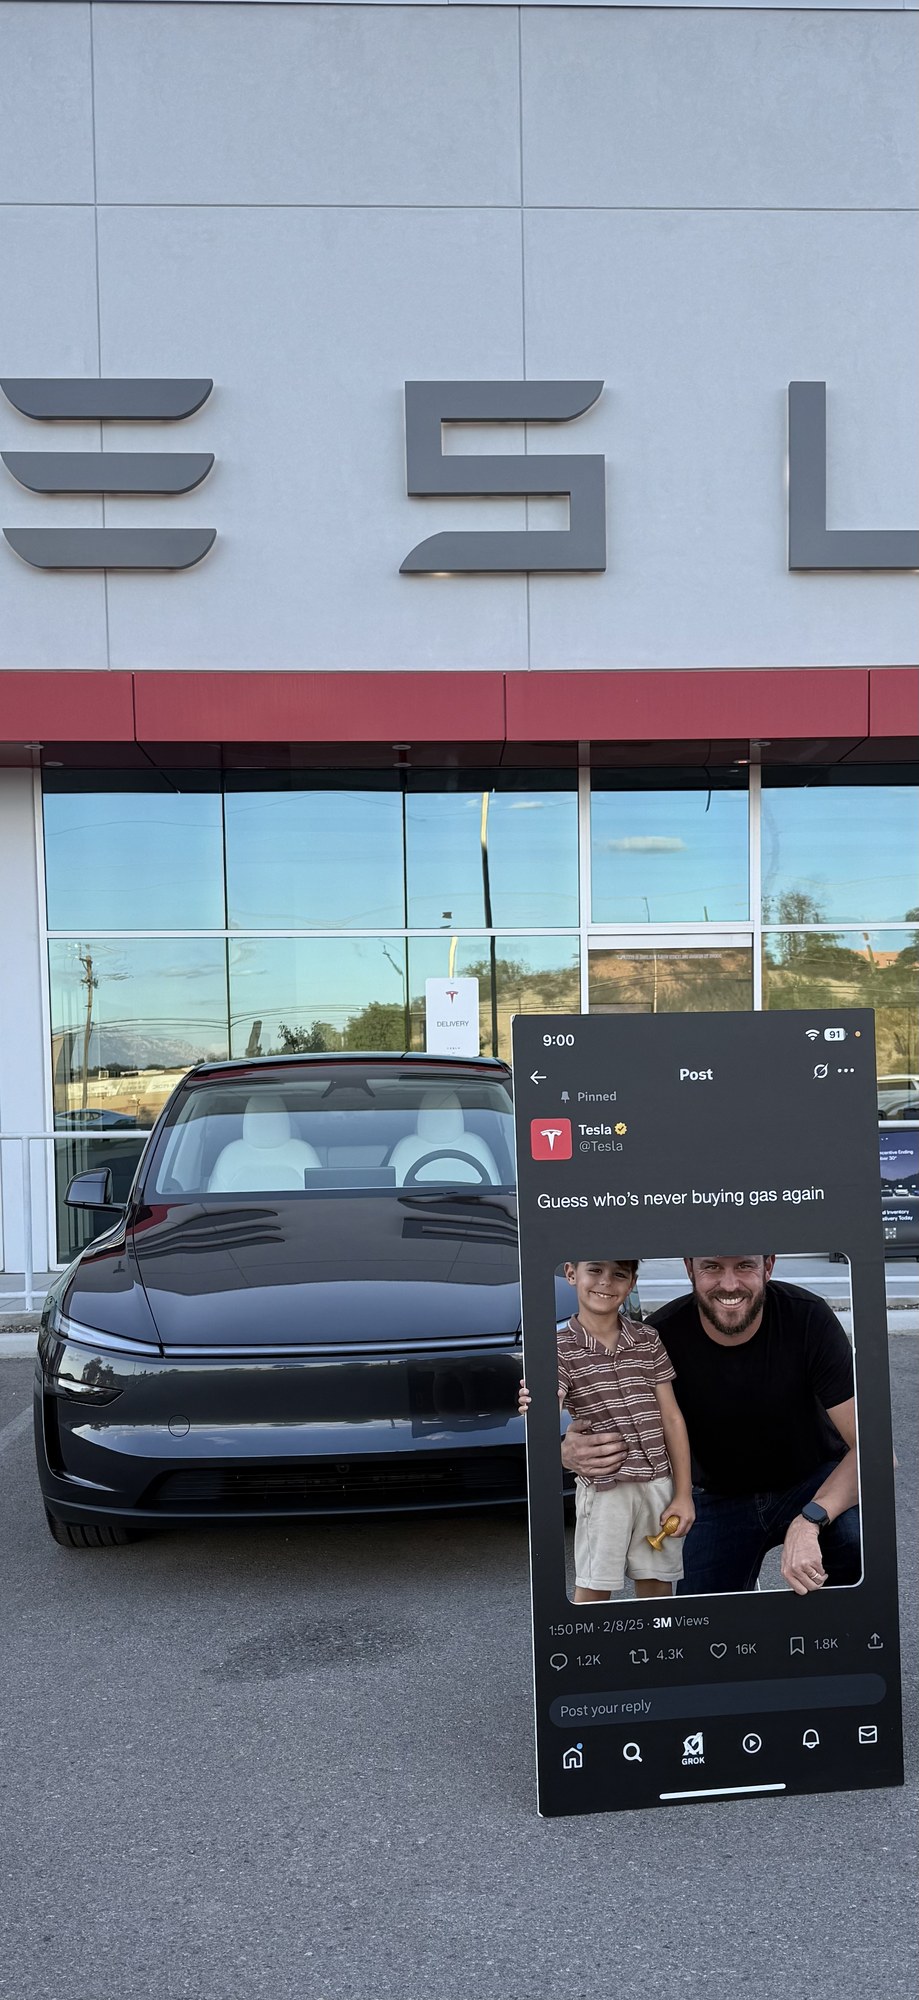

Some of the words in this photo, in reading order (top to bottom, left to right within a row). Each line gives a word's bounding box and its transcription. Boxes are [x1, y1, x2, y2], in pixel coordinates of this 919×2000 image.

[543, 1034, 575, 1047] 9:00
[829, 1030, 841, 1039] 91
[679, 1068, 714, 1081] Post
[577, 1090, 617, 1102] Pinned
[578, 1124, 612, 1136] Tesla
[579, 1140, 623, 1152] @Tesla
[537, 1193, 588, 1209] Guess
[644, 1193, 687, 1206] never
[692, 1188, 743, 1207] buying
[749, 1190, 777, 1205] gas
[782, 1185, 825, 1205] again
[603, 1619, 644, 1633] 2/8/25
[653, 1616, 672, 1629] 3M
[674, 1614, 709, 1627] Views
[735, 1643, 757, 1655] 16K
[814, 1638, 838, 1650] 1.8K
[656, 1648, 684, 1660] 4.3K
[576, 1654, 601, 1667] 1.2K
[560, 1704, 588, 1718] Post
[591, 1704, 618, 1719] your
[621, 1699, 651, 1717] reply
[681, 1757, 705, 1765] GROK
